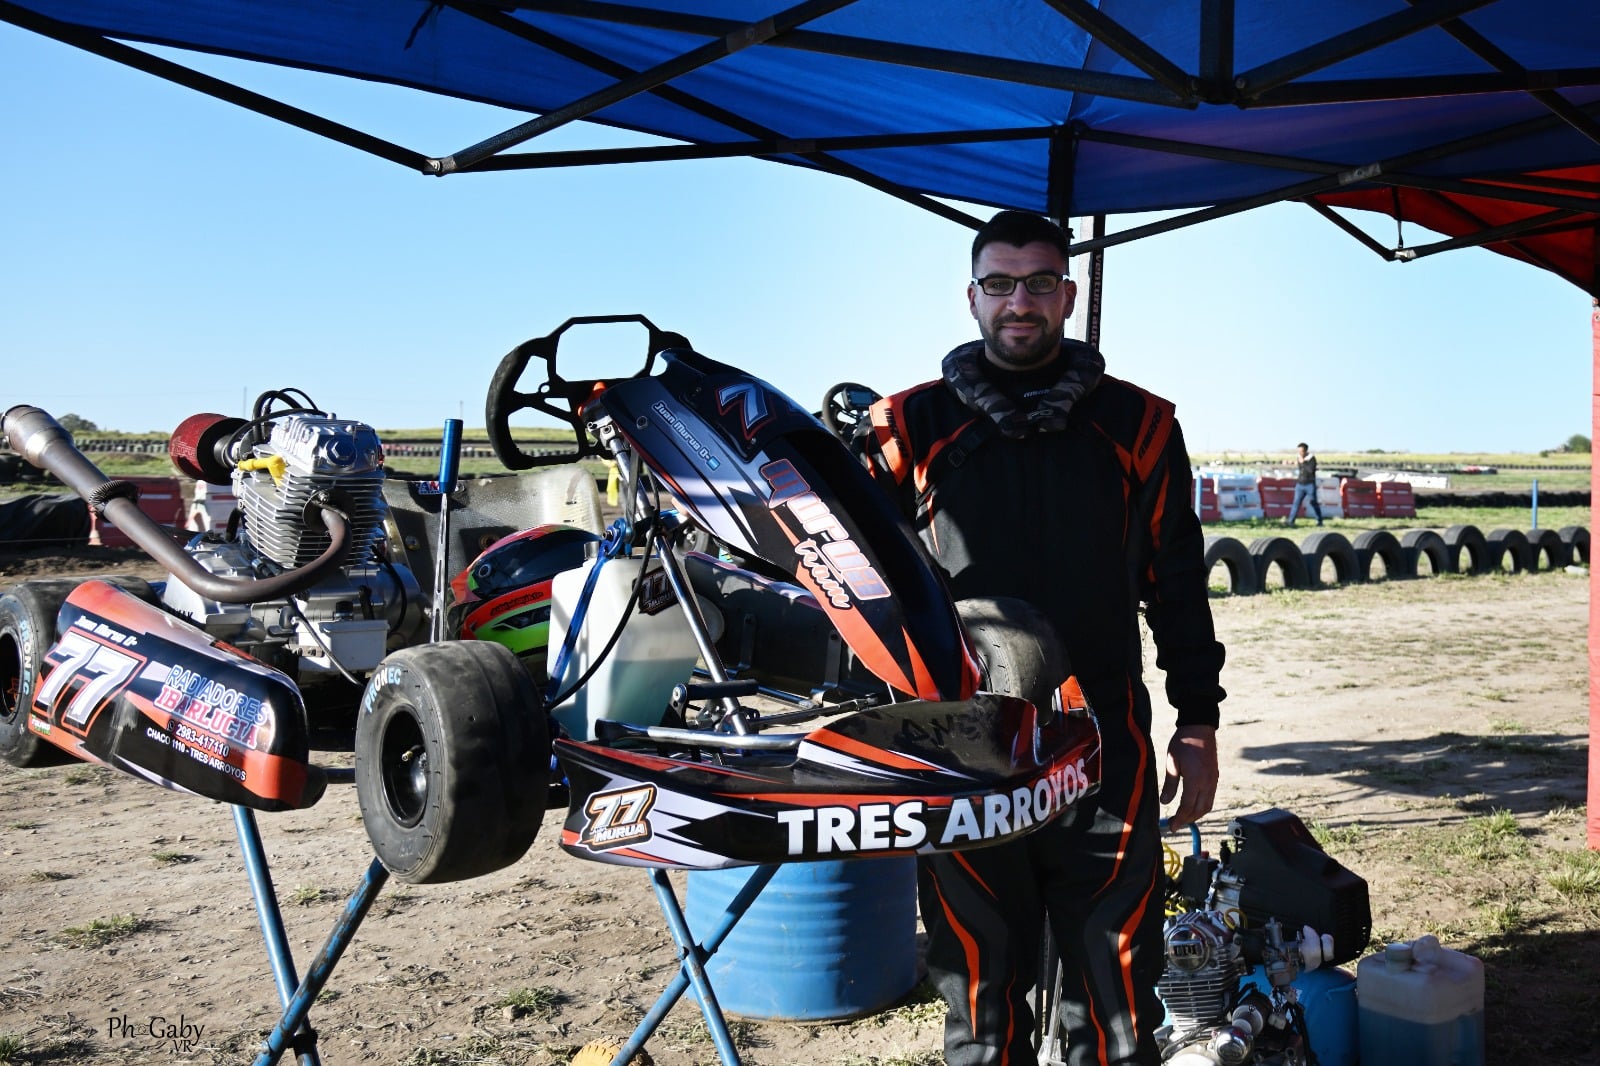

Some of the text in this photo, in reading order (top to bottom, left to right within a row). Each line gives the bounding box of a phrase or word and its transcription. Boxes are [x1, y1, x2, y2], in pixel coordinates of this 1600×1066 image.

[655, 402, 676, 424] Juan
[673, 421, 701, 451] Murua
[35, 629, 142, 728] 77
[165, 664, 270, 725] RADIADORES
[364, 667, 402, 714] PRONEC
[153, 684, 260, 751] IBARLUCIA
[175, 723, 231, 758] 2983-417110
[146, 727, 171, 746] CHACO
[190, 747, 209, 764] TRES
[208, 757, 247, 781] ARROYOS
[592, 789, 651, 831] 77
[778, 758, 1090, 855] TRES ARROYOS
[595, 823, 646, 843] MURUA
